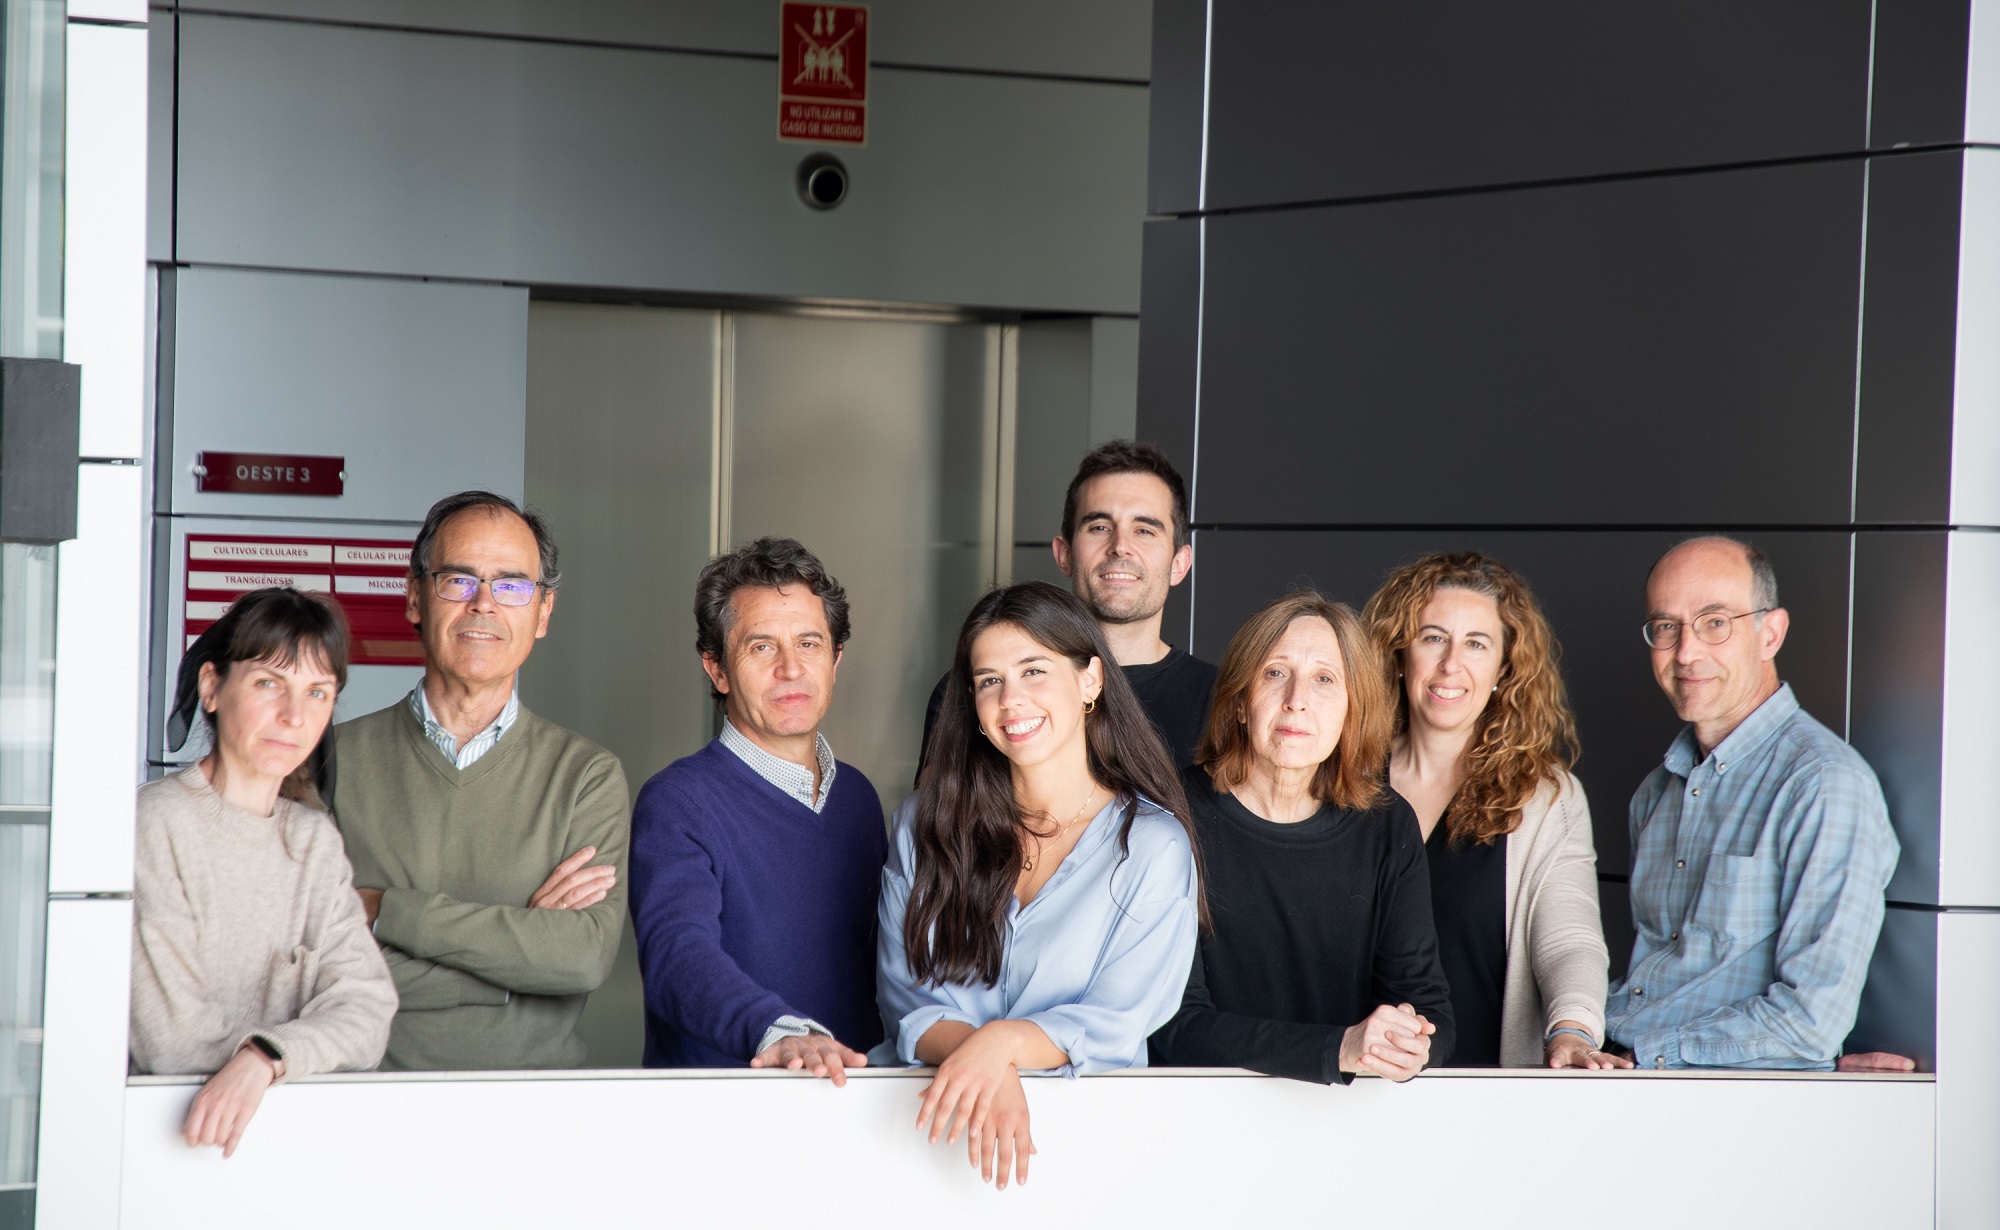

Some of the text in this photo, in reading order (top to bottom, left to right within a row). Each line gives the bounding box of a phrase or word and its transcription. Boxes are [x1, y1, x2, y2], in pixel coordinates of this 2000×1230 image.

[789, 105, 856, 122] NO UTILIZAR EN
[782, 120, 862, 138] CASO DE INCENDIO
[236, 465, 311, 483] OESTE 3
[213, 546, 309, 556] CULTIVOS CELULARES
[224, 574, 294, 585] TRANSGÉNESIS
